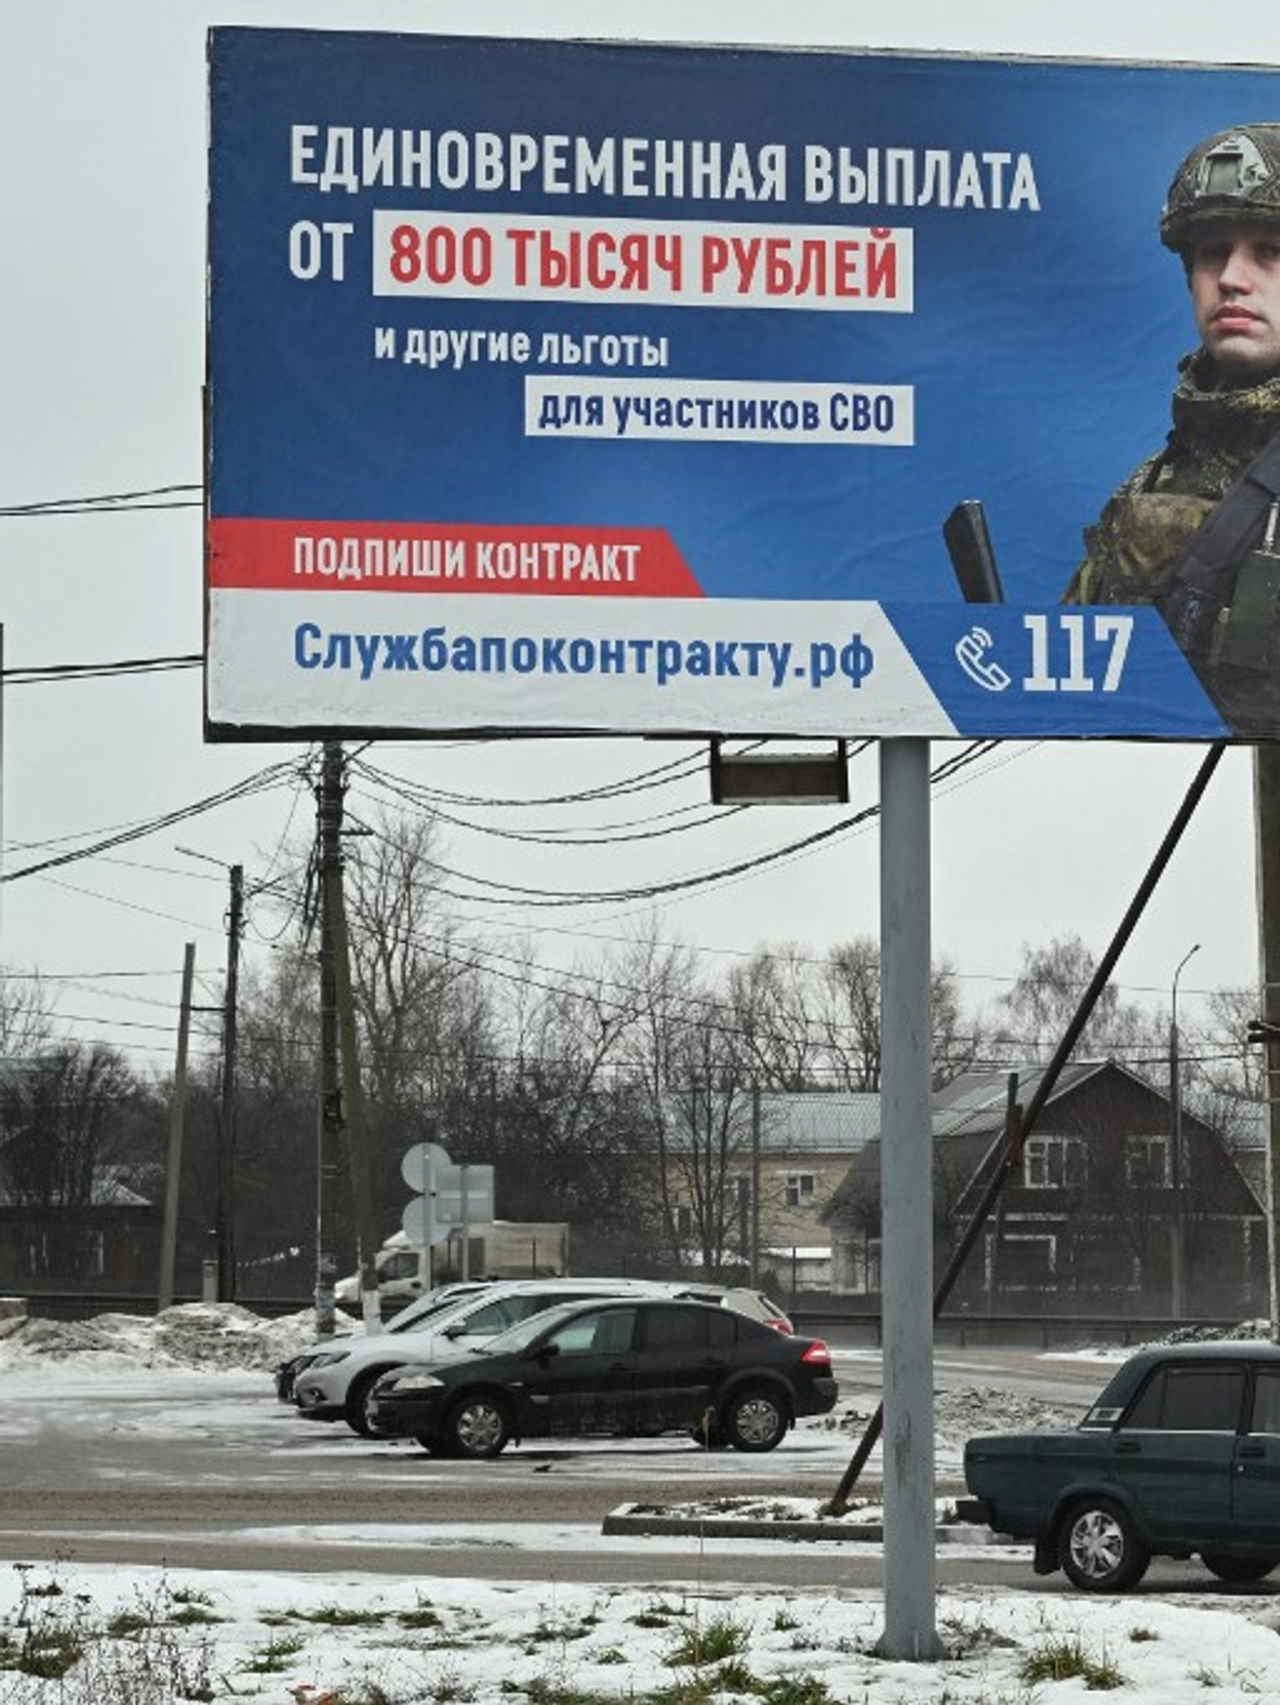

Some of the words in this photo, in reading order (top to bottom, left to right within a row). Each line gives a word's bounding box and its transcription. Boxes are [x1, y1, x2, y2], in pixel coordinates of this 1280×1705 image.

[290, 124, 786, 201] ЕДИНОВРЕМЕННАЯ
[806, 146, 1041, 211] ВЫПЛАТА
[289, 220, 354, 281] ОТ
[389, 224, 492, 286] 800
[506, 228, 683, 292] ТЫСЯЧ
[702, 227, 897, 299] РУБЛЕЙ
[375, 327, 395, 358] и
[403, 329, 531, 369] другие
[538, 334, 668, 367] льготы
[538, 394, 604, 430] для
[613, 395, 820, 435] участников
[829, 393, 895, 433] СВО
[294, 537, 465, 580] ПОДПИШИ
[476, 541, 641, 582] КОНТРАКТ
[294, 622, 874, 689] Службапоконтракту.рф
[1023, 614, 1134, 692] 117
